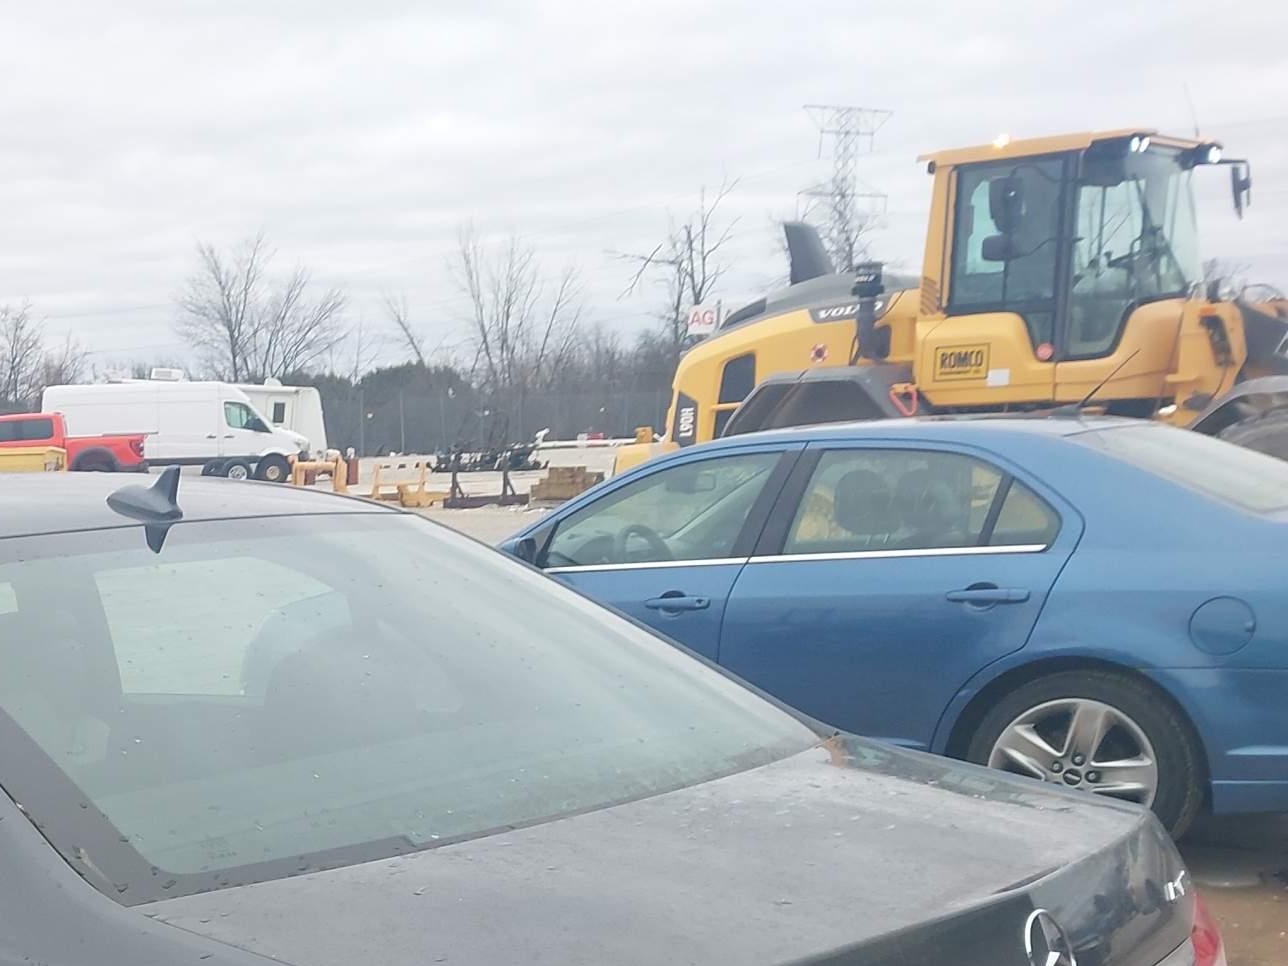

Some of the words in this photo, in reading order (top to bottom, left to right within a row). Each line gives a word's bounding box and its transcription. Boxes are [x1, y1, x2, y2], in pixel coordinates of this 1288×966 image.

[689, 309, 714, 325] AG
[940, 350, 984, 369] ROMCO
[679, 407, 695, 437] L90H
